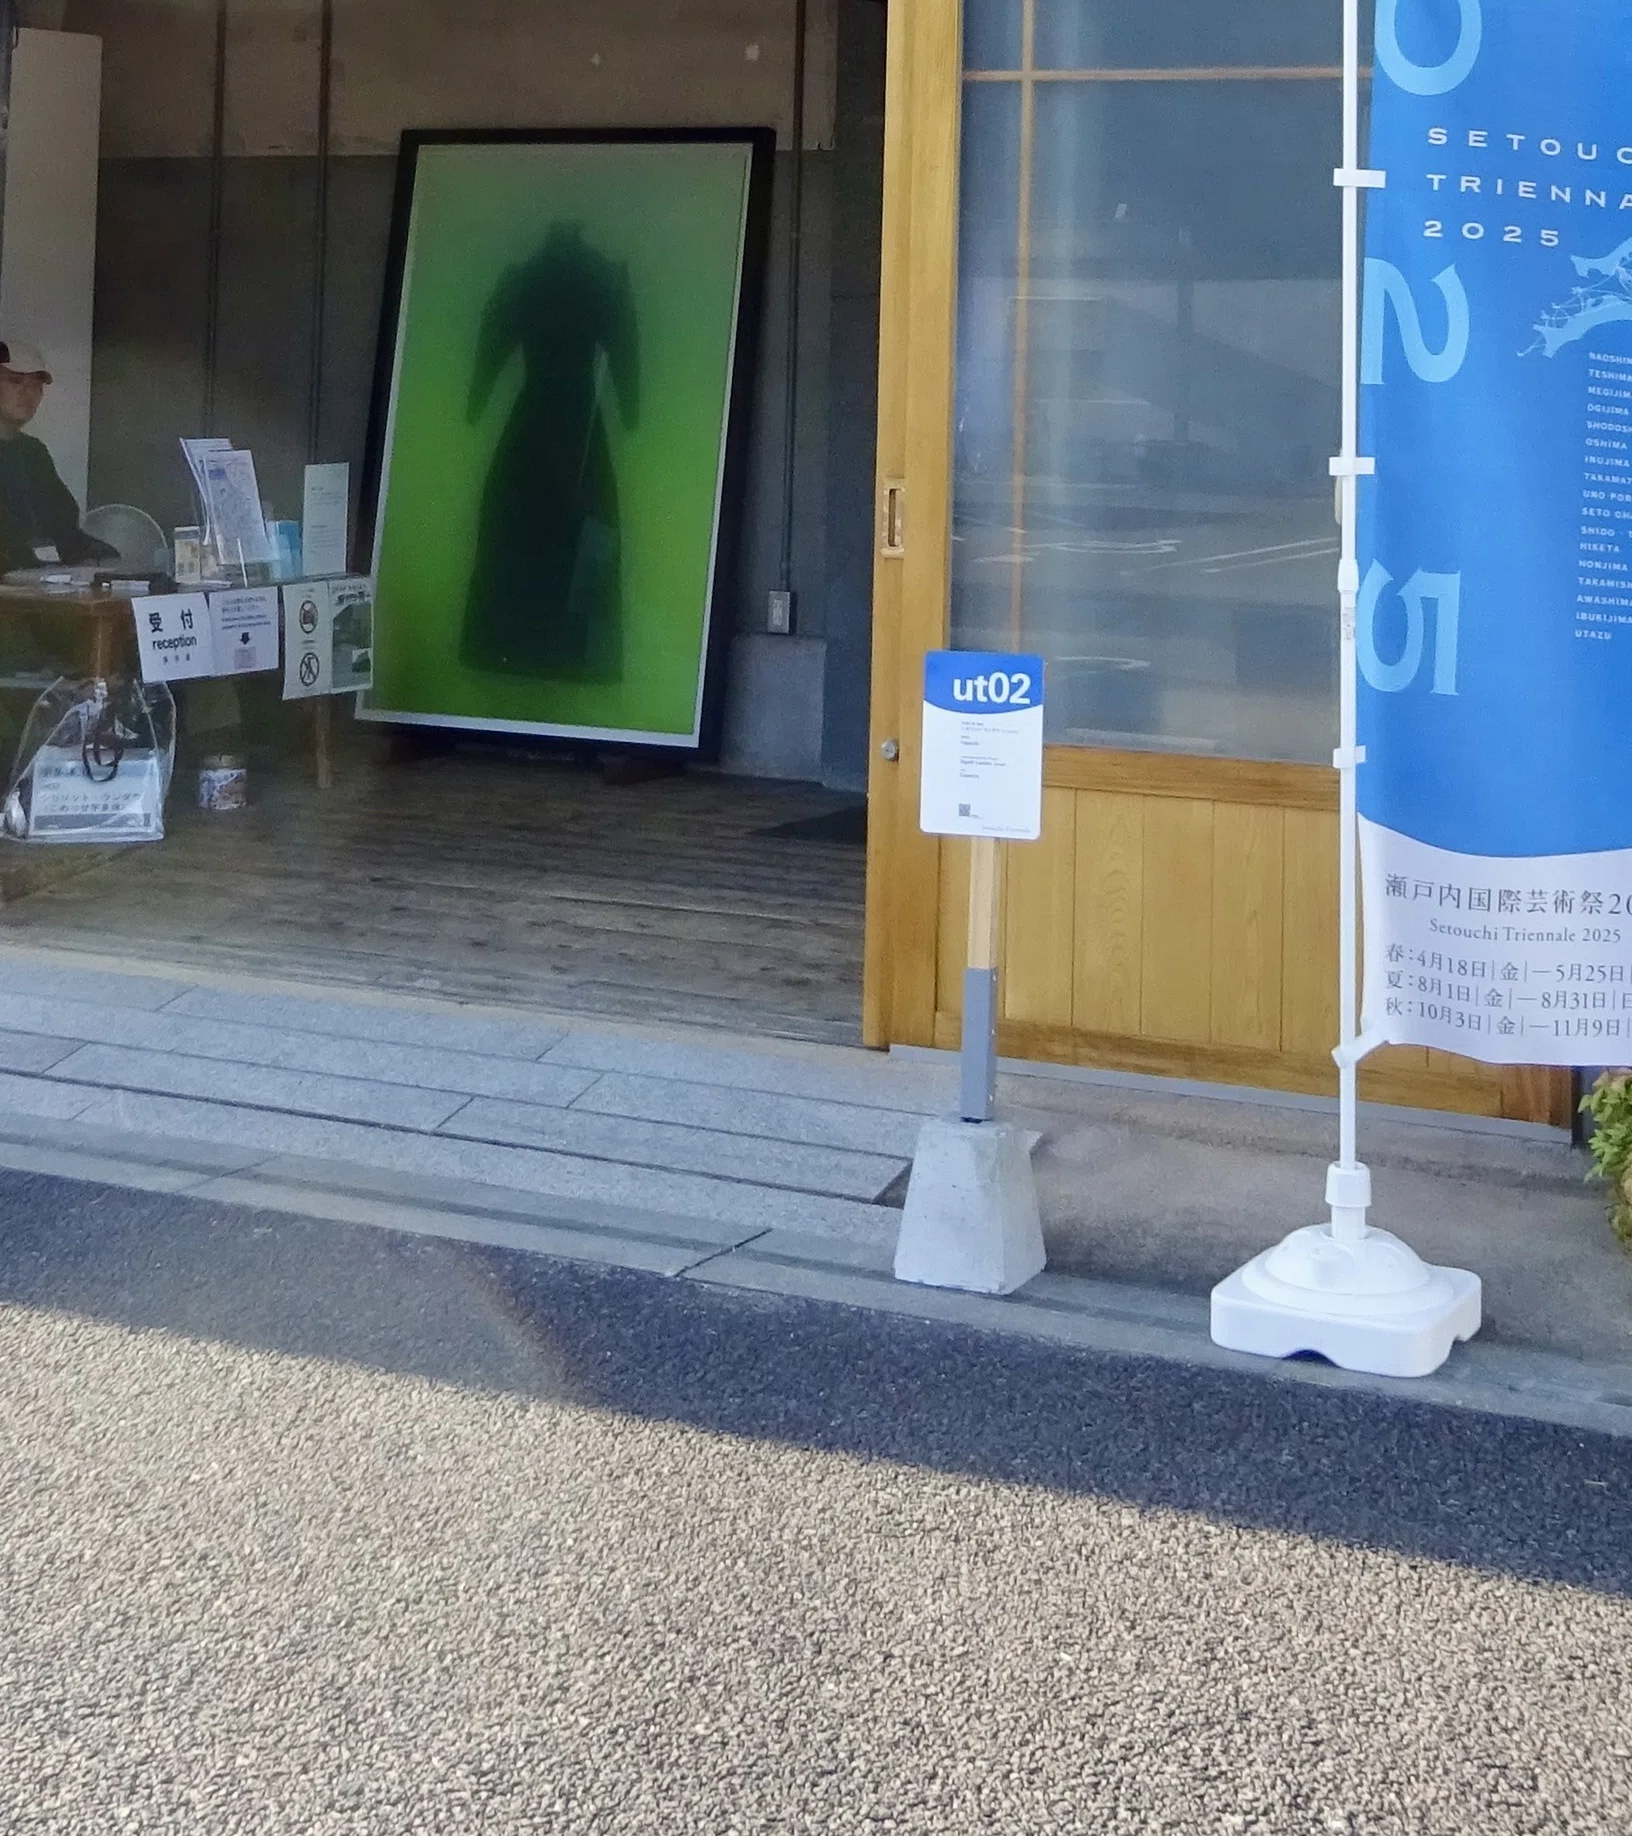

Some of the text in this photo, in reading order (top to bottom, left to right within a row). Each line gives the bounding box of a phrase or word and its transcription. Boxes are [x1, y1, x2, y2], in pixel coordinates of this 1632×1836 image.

[1423, 219, 1560, 247] 2025
[1588, 369, 1632, 382] TESHIMA
[1585, 438, 1627, 449] OSHIMA
[1582, 507, 1610, 517] SETO
[149, 609, 194, 633] 受付
[152, 634, 197, 651] reception
[953, 672, 1031, 704] ut02
[1429, 917, 1621, 943] Setouchi Triennale 2025
